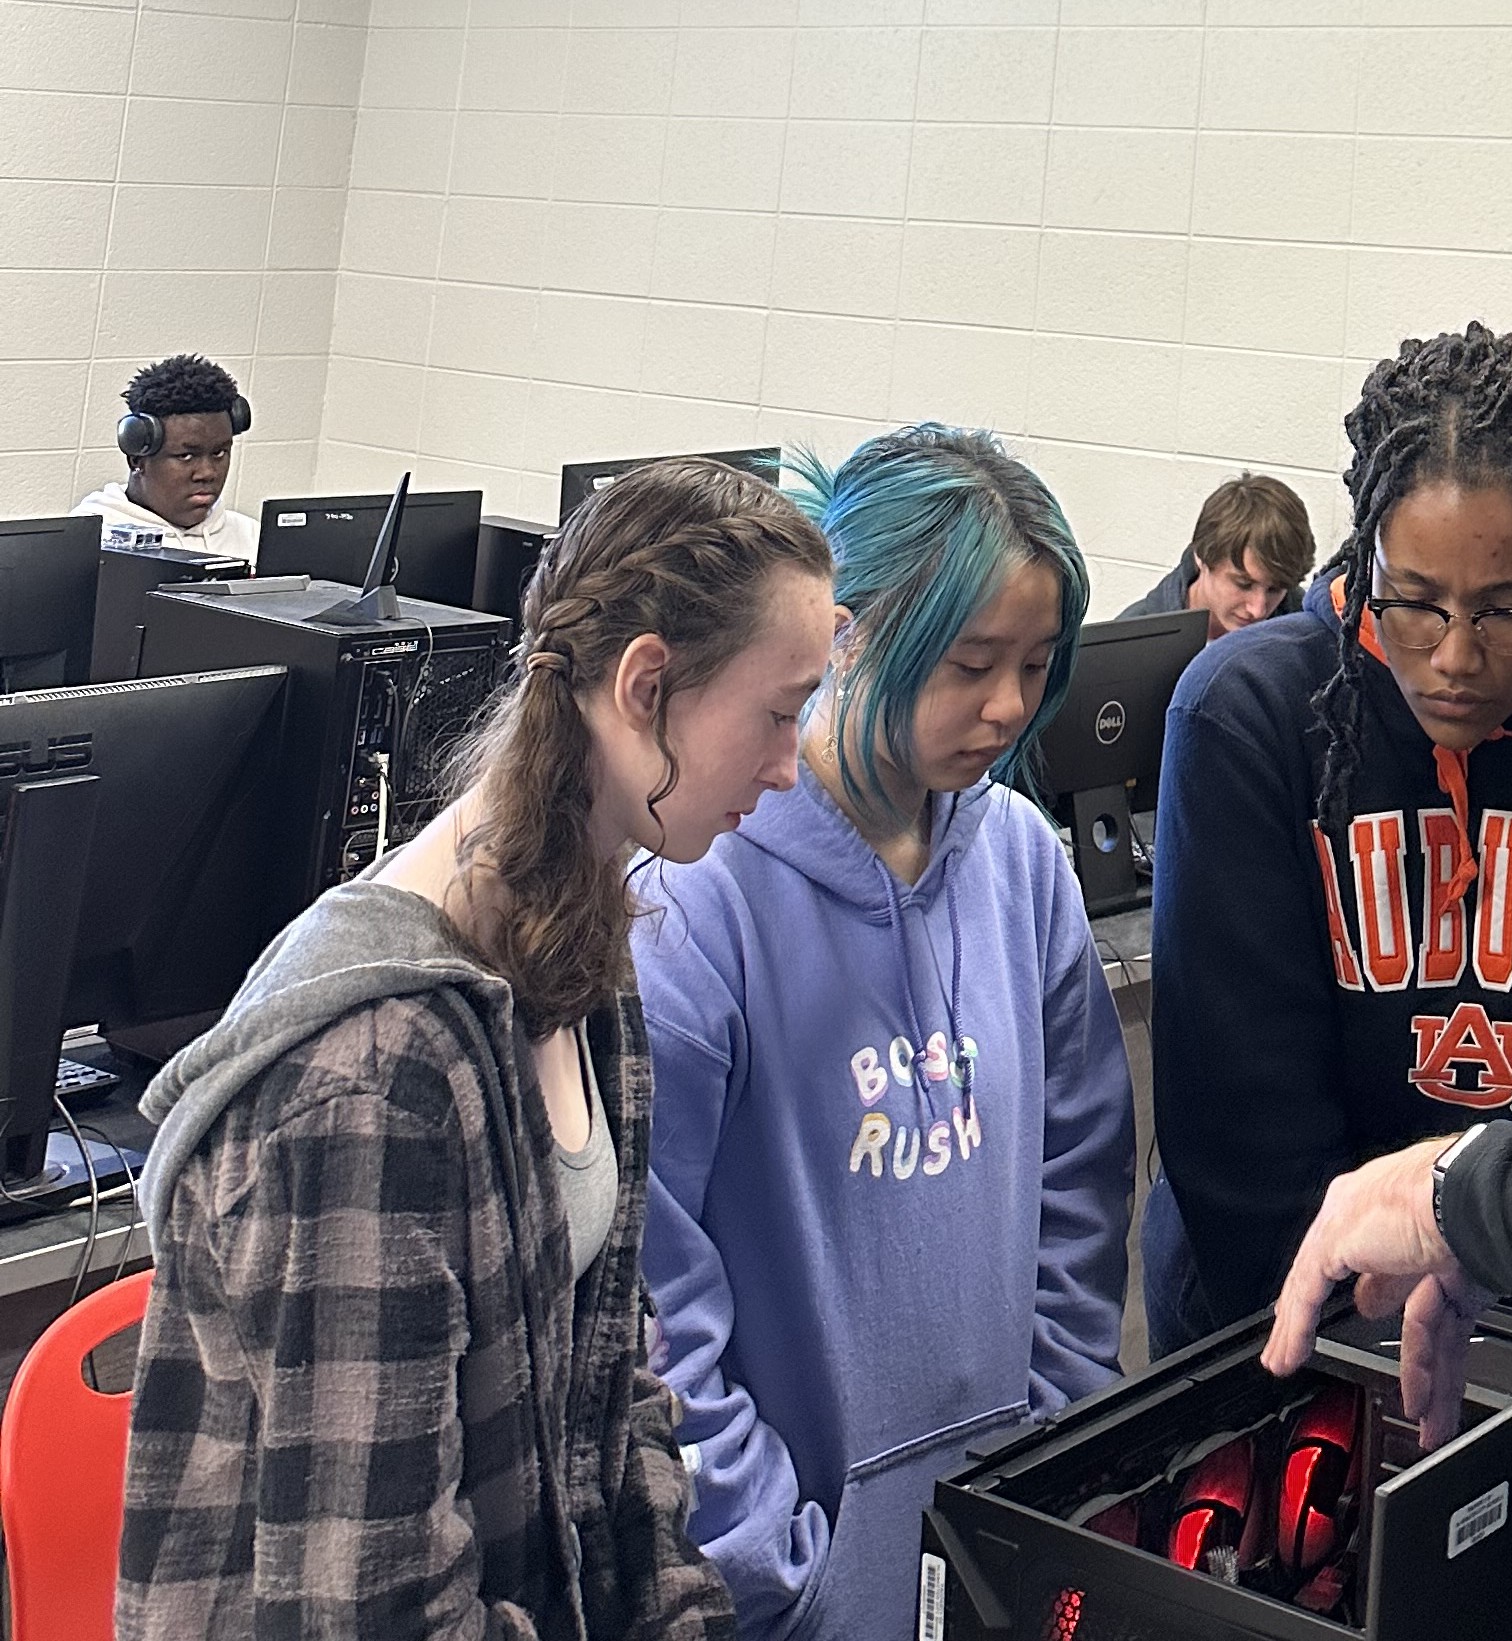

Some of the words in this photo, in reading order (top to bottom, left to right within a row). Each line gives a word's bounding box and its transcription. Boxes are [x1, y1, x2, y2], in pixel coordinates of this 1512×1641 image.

[1098, 716, 1122, 731] DELL
[0, 732, 93, 778] SUS
[849, 1094, 982, 1180] RUSH
